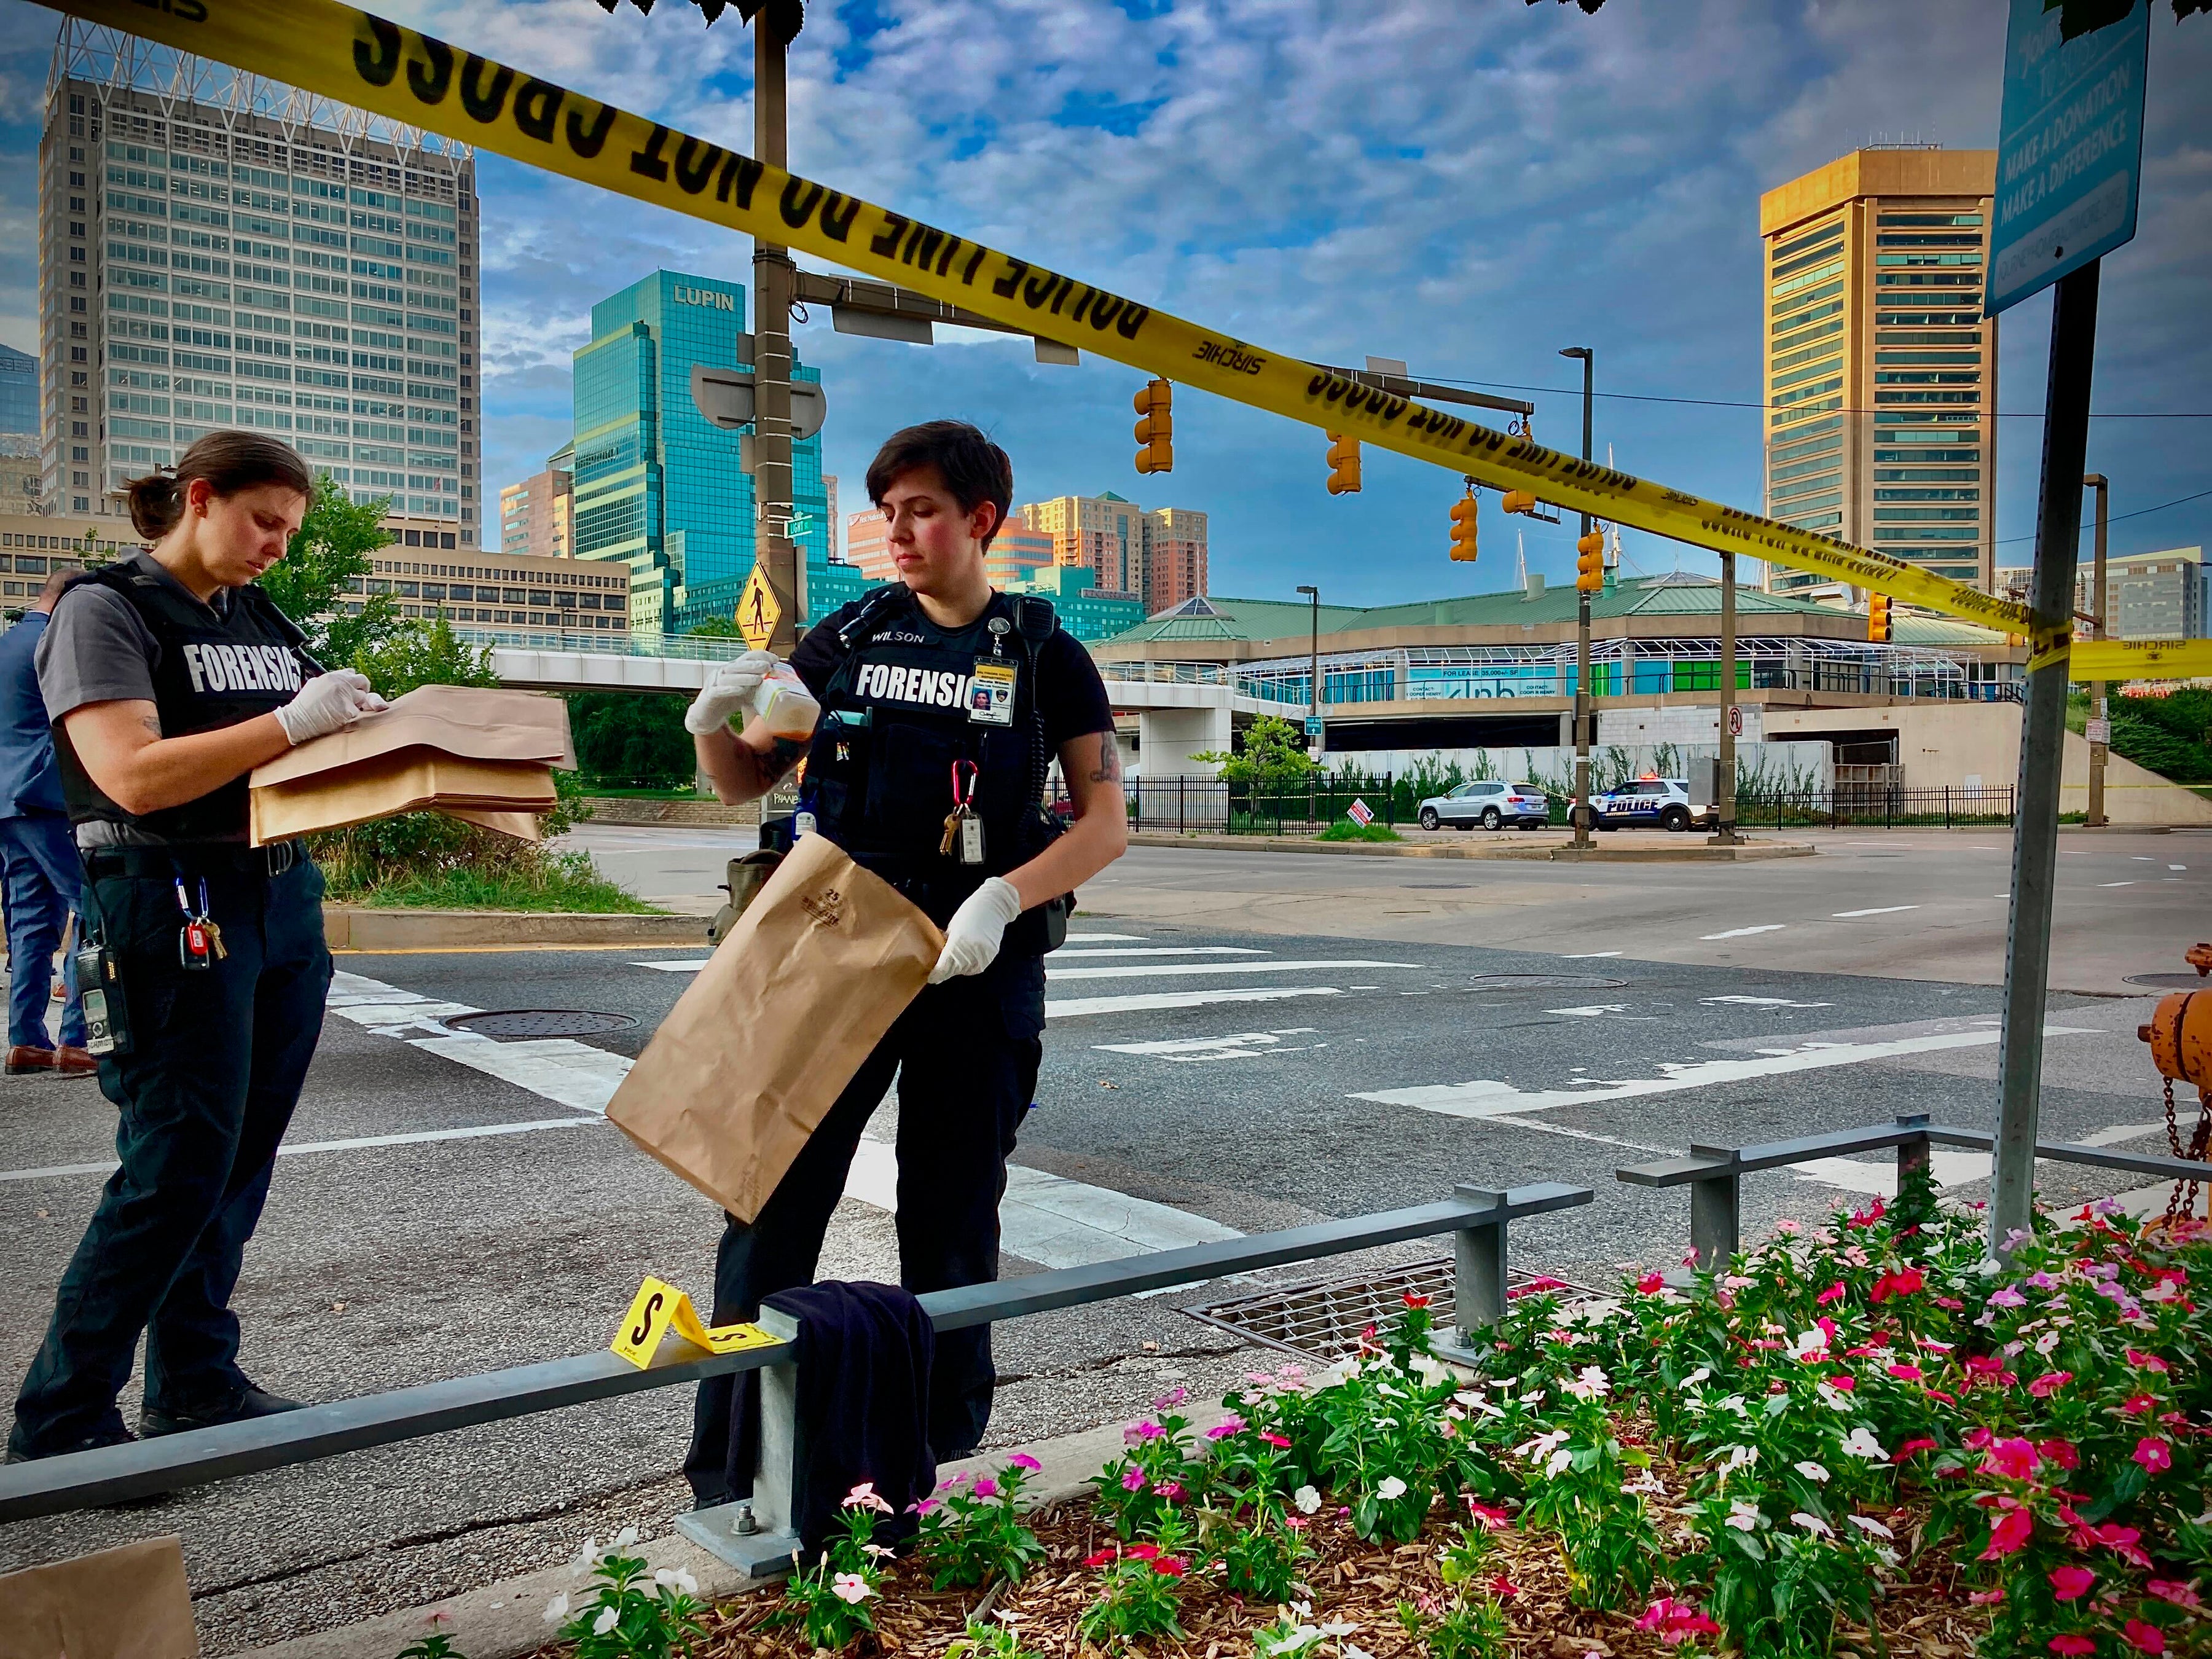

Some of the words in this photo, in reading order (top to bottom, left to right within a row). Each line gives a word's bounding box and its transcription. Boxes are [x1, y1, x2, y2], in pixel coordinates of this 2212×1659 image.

[2005, 135, 2039, 185] MAKE
[2041, 127, 2050, 158] A
[2053, 60, 2130, 149] DONATION
[2001, 178, 2035, 227] MAKE
[2037, 171, 2045, 202] A
[2049, 108, 2127, 194] DIFFERENCE
[673, 285, 734, 312] LUPIN
[1192, 340, 1267, 376] SIRCHIE
[790, 520, 804, 535] LIGHT
[872, 631, 925, 643] WILSON
[1606, 799, 1660, 813] POLICE
